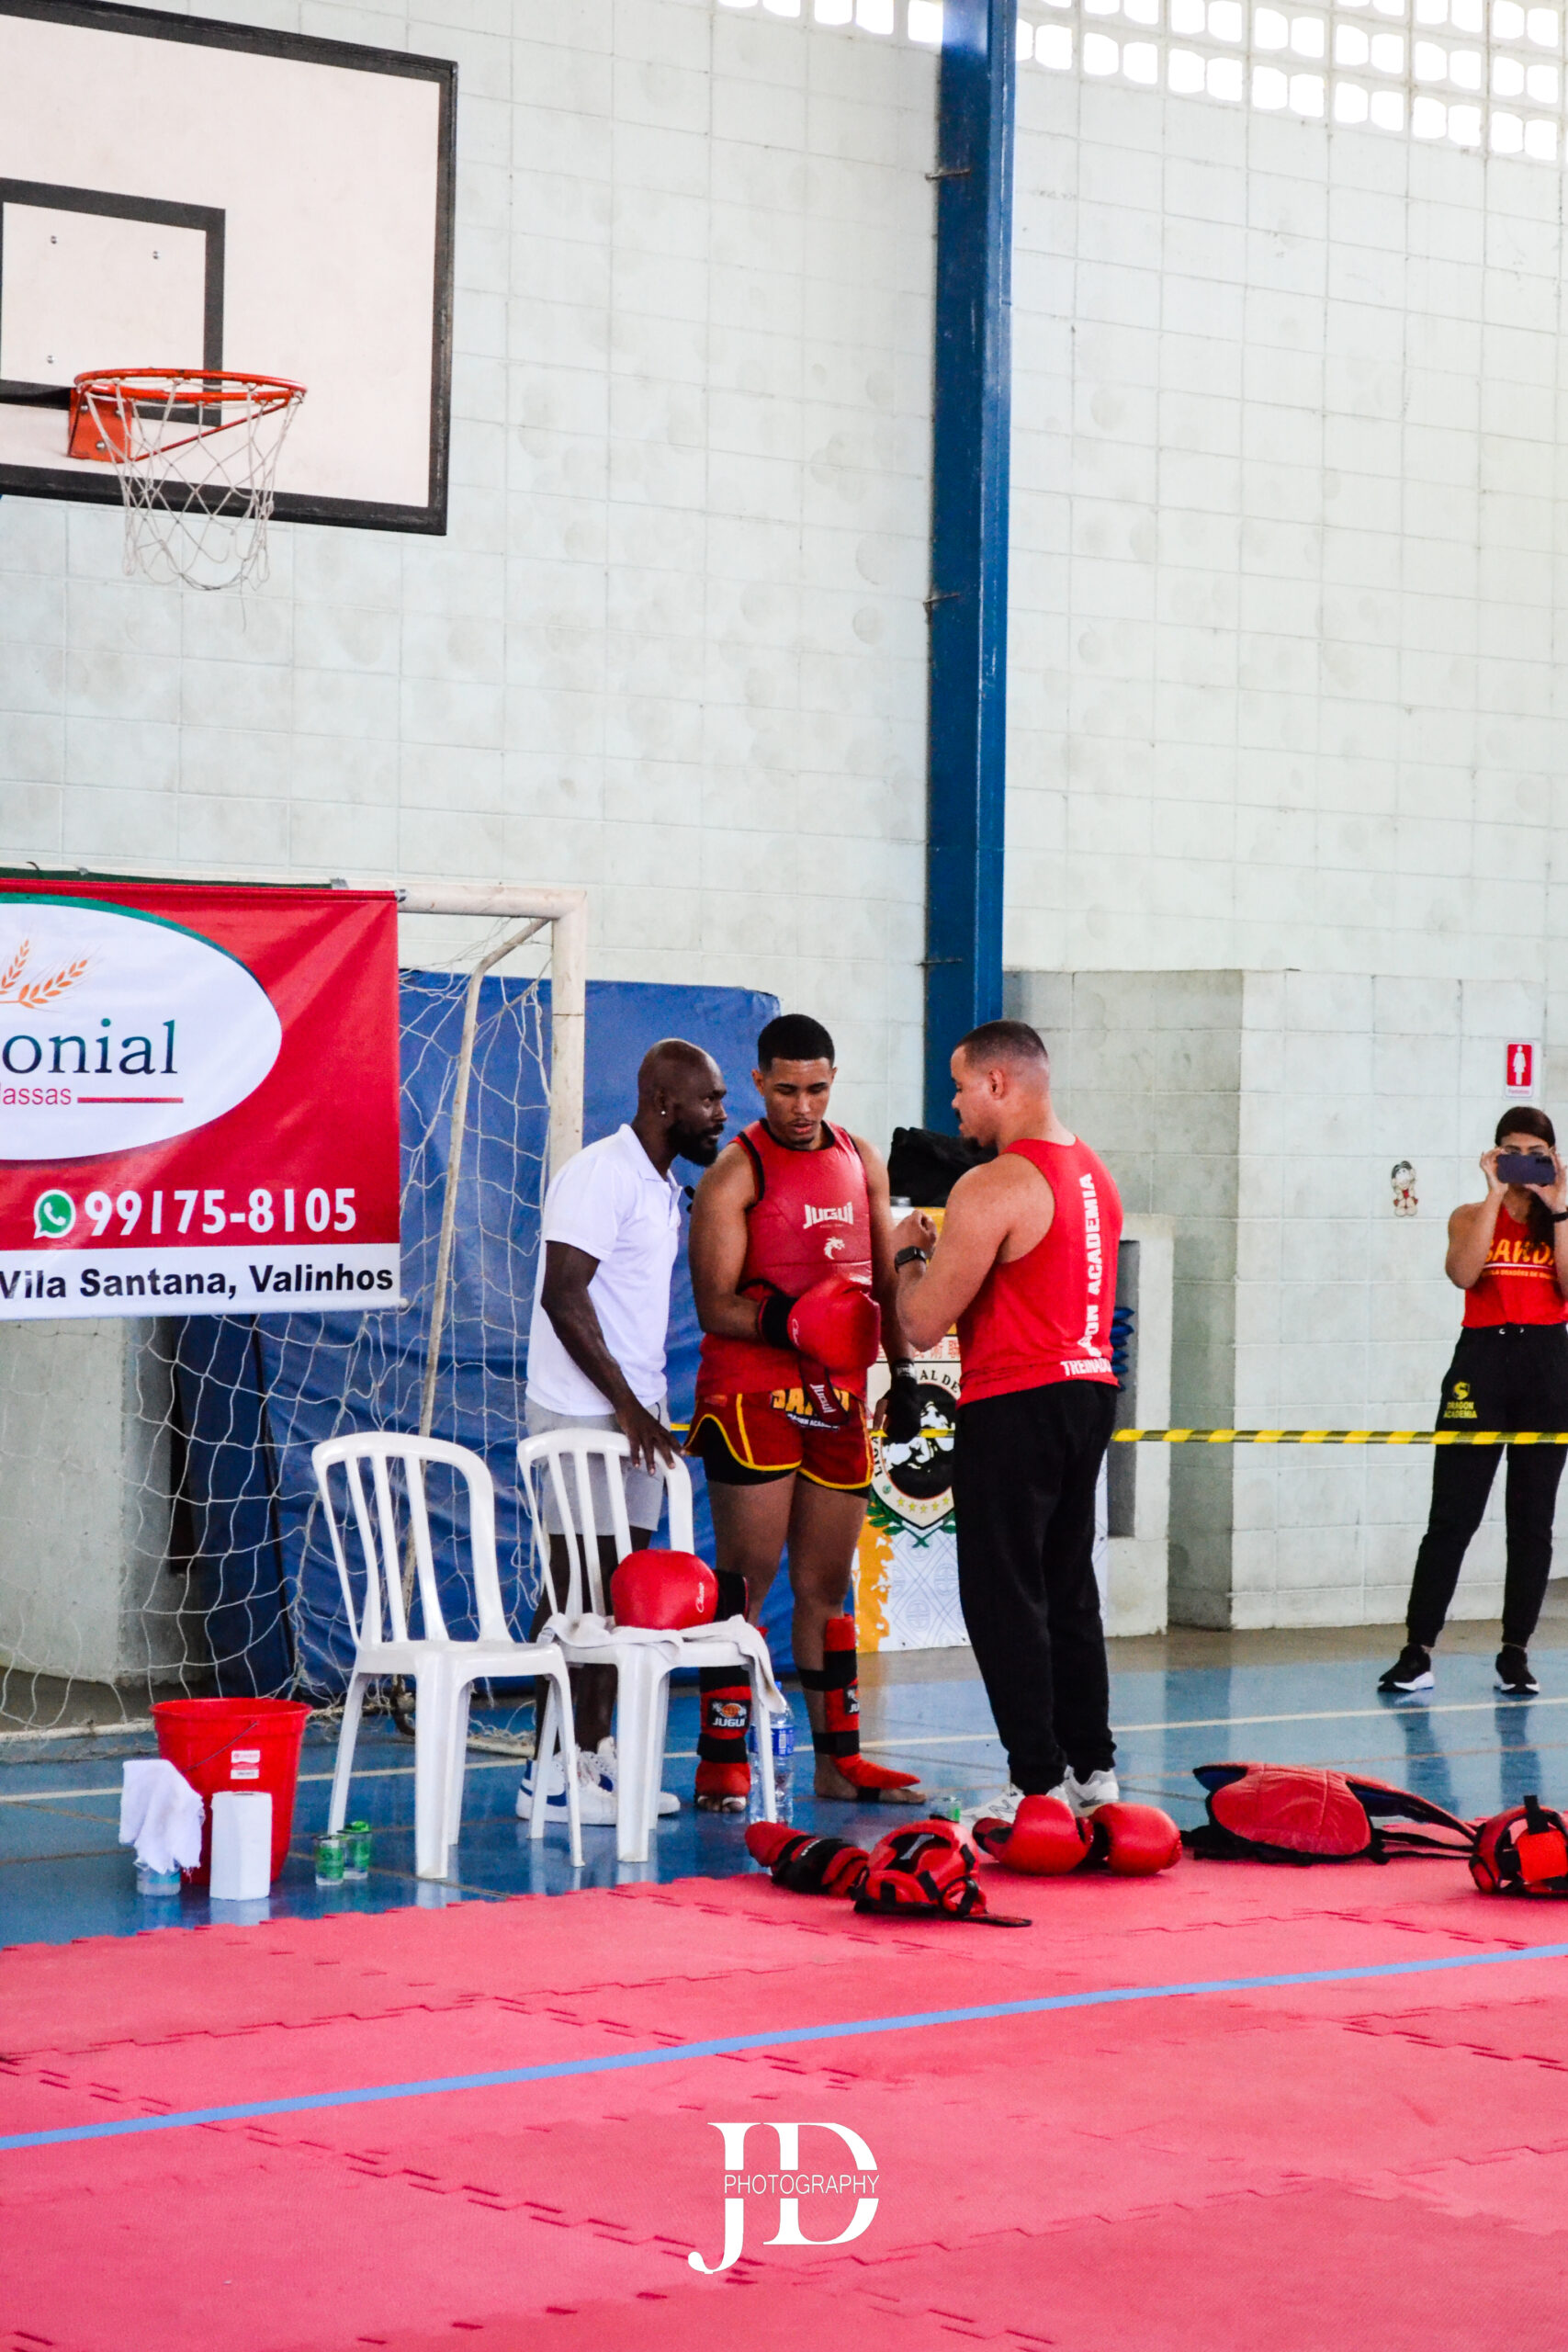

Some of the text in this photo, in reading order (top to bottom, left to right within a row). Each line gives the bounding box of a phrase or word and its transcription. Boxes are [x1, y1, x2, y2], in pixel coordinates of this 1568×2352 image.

[2, 1018, 178, 1075] onial
[0, 1082, 72, 1105] assas
[85, 1188, 357, 1237] 99175-8105
[803, 1201, 854, 1229] JUGUI
[1079, 1172, 1103, 1295] ACADEMIA
[0, 1263, 394, 1300] Vila Santana, Valinhos
[712, 1717, 746, 1727] JUGUI
